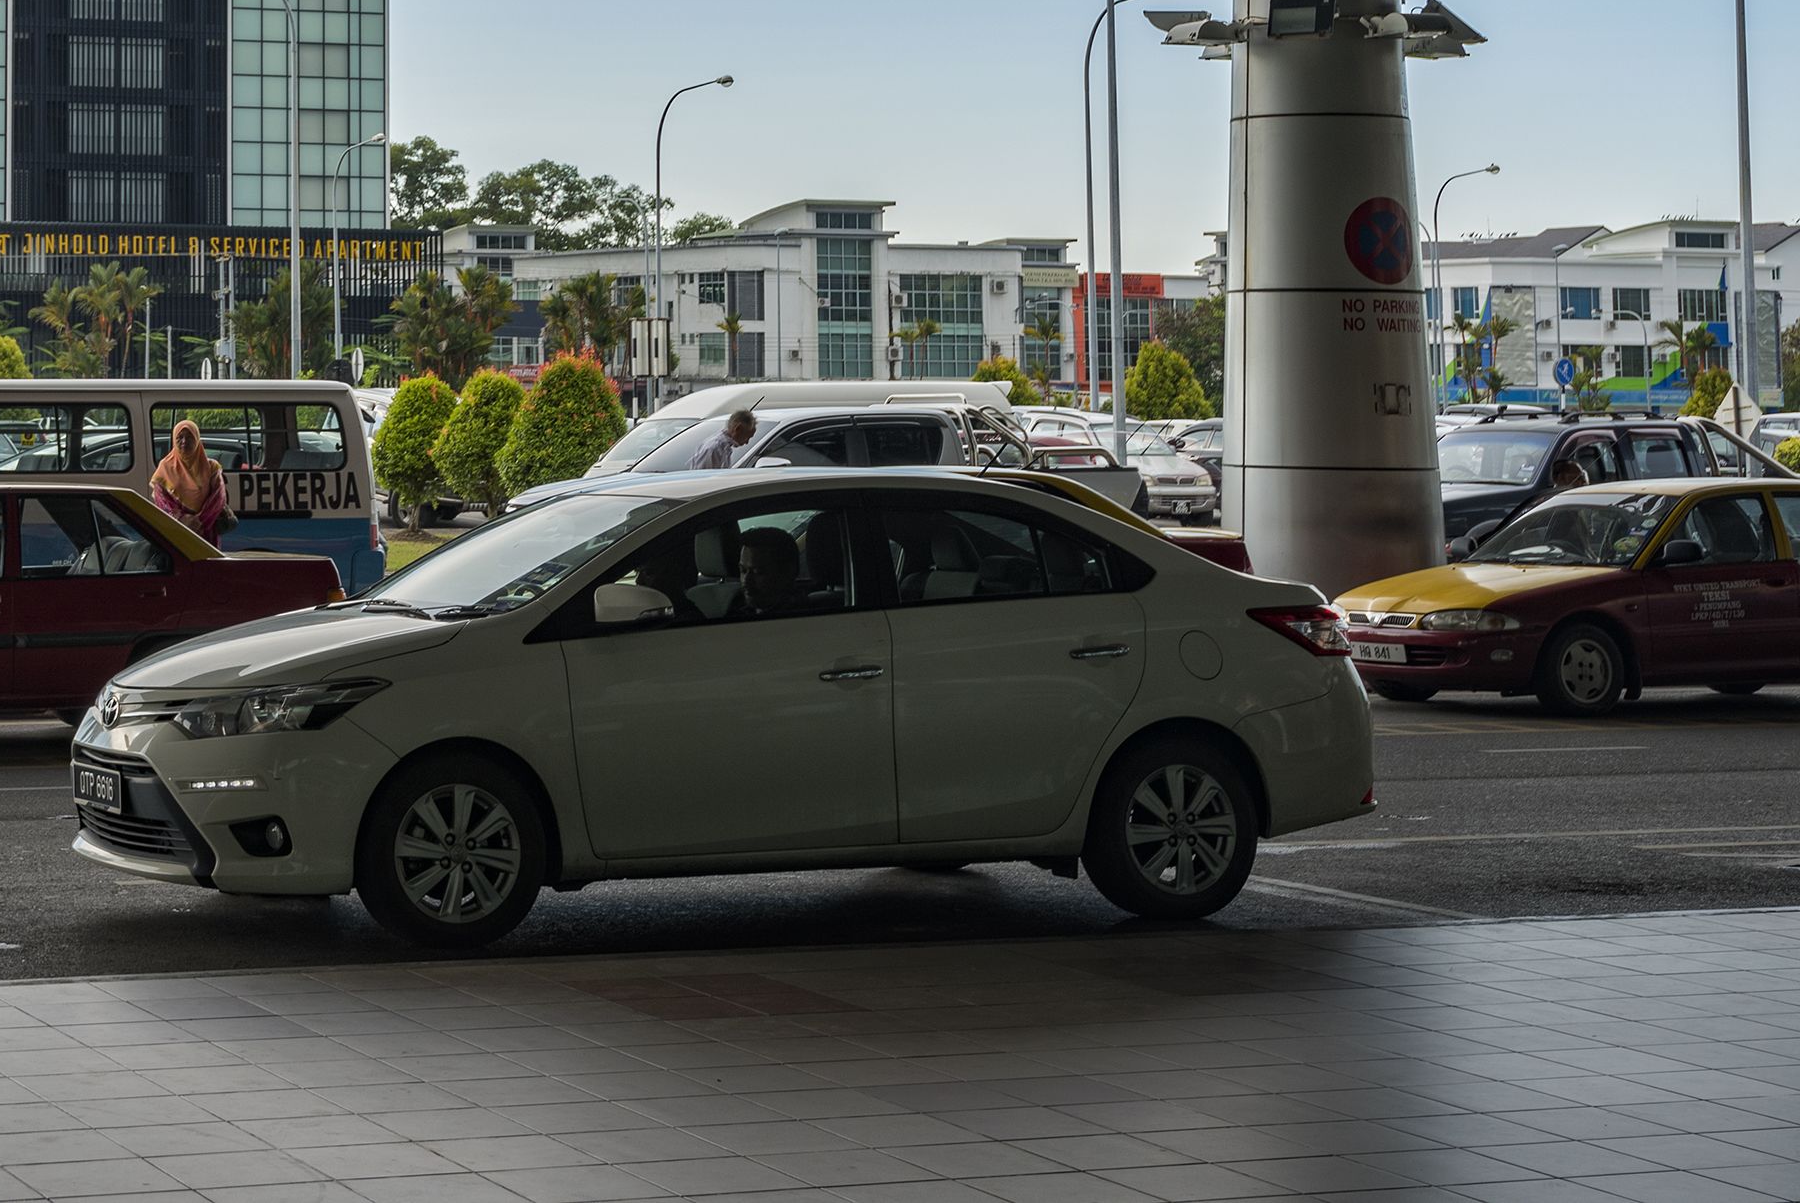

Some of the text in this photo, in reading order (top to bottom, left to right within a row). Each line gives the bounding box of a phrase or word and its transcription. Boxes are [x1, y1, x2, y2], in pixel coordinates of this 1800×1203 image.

[23, 233, 109, 254] JINHOLD
[119, 235, 179, 255] HOTEL
[313, 239, 423, 261] APARTMENT
[1342, 299, 1420, 314] NO PARKING
[1343, 317, 1421, 333] NO WAITING
[238, 472, 361, 511] PEKERJA
[1702, 590, 1730, 601] TEKSI
[1374, 646, 1391, 659] 841
[96, 774, 114, 801] 6616
